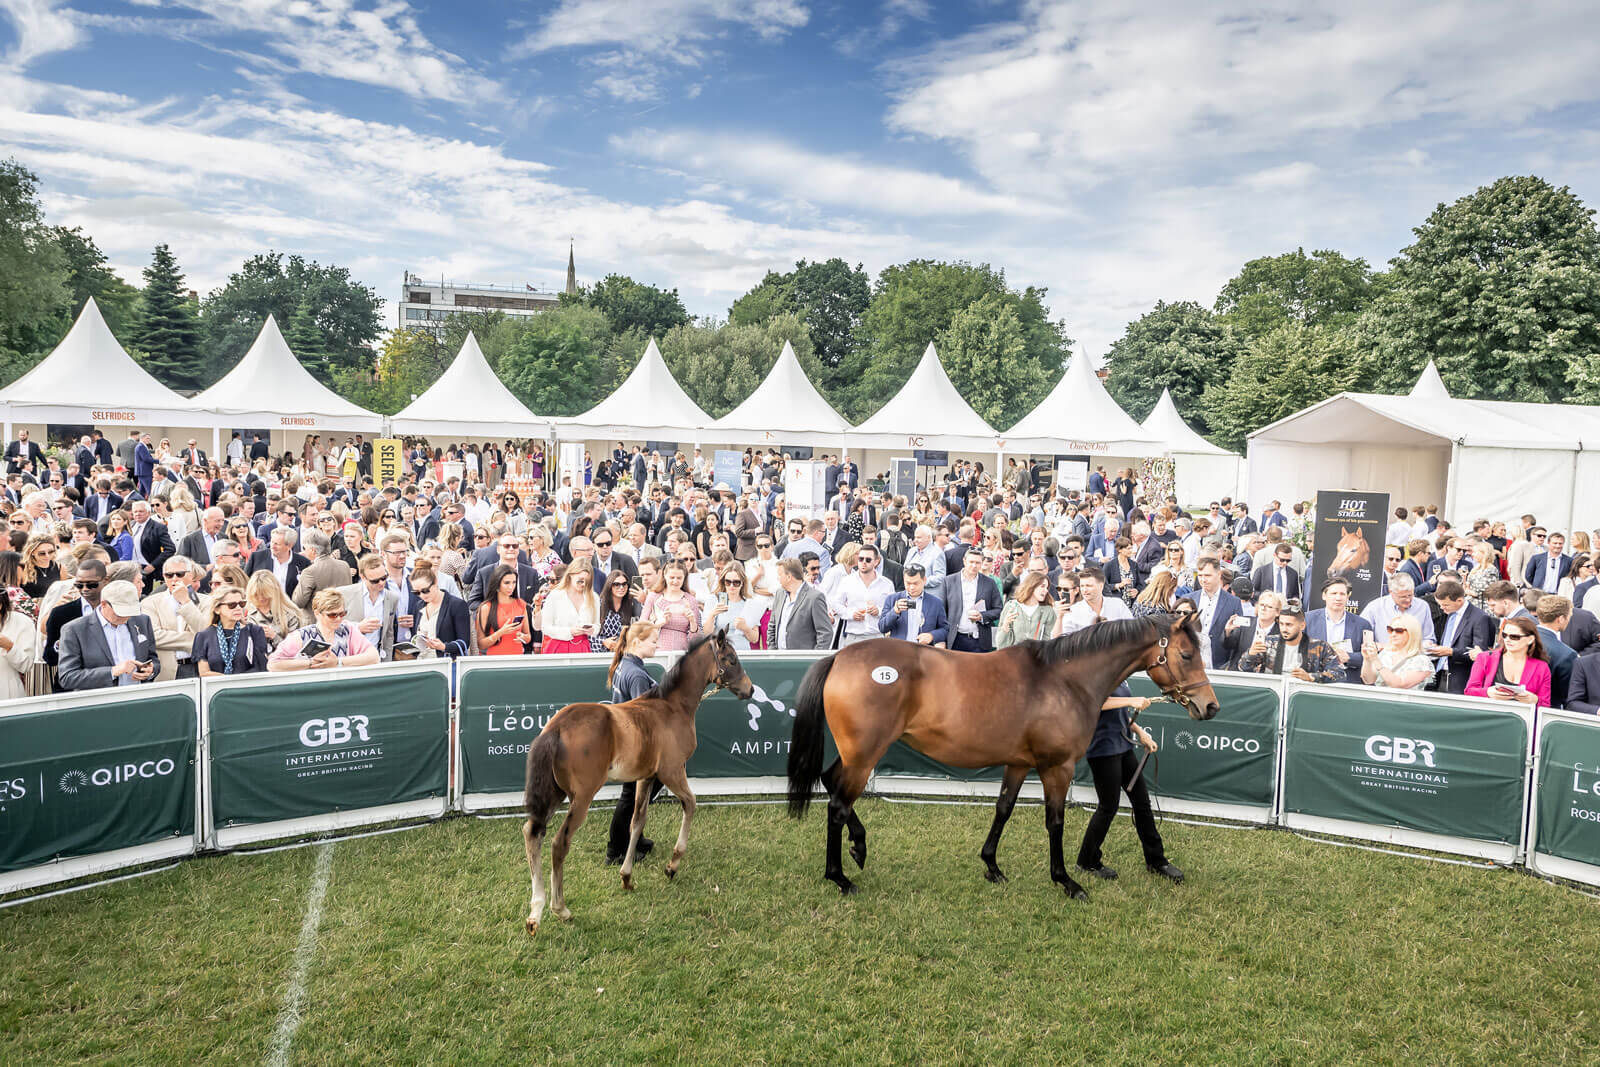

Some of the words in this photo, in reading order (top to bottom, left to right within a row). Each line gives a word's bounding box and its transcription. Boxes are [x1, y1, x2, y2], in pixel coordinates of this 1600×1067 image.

[91, 411, 136, 421] SELFRIDGES
[280, 416, 315, 426] SELFRIDGES
[381, 445, 395, 485] SELFRI
[1339, 500, 1367, 510] HOT
[879, 671, 891, 681] 15
[488, 709, 559, 732] Léou
[298, 714, 371, 747] GBR
[488, 743, 514, 755] ROSÉ
[1196, 735, 1260, 753] QIPCO
[1364, 734, 1437, 768] GBR
[286, 747, 383, 766] INTERNATIONAL
[91, 758, 175, 787] QIPCO
[297, 770, 320, 778] GREAT
[321, 767, 347, 775] BRITISH
[348, 763, 374, 771] RACING
[1351, 765, 1449, 784] INTERNATIONAL
[1360, 780, 1382, 788] GREAT
[1383, 783, 1410, 791] BRITISH
[1411, 787, 1437, 795] RACING
